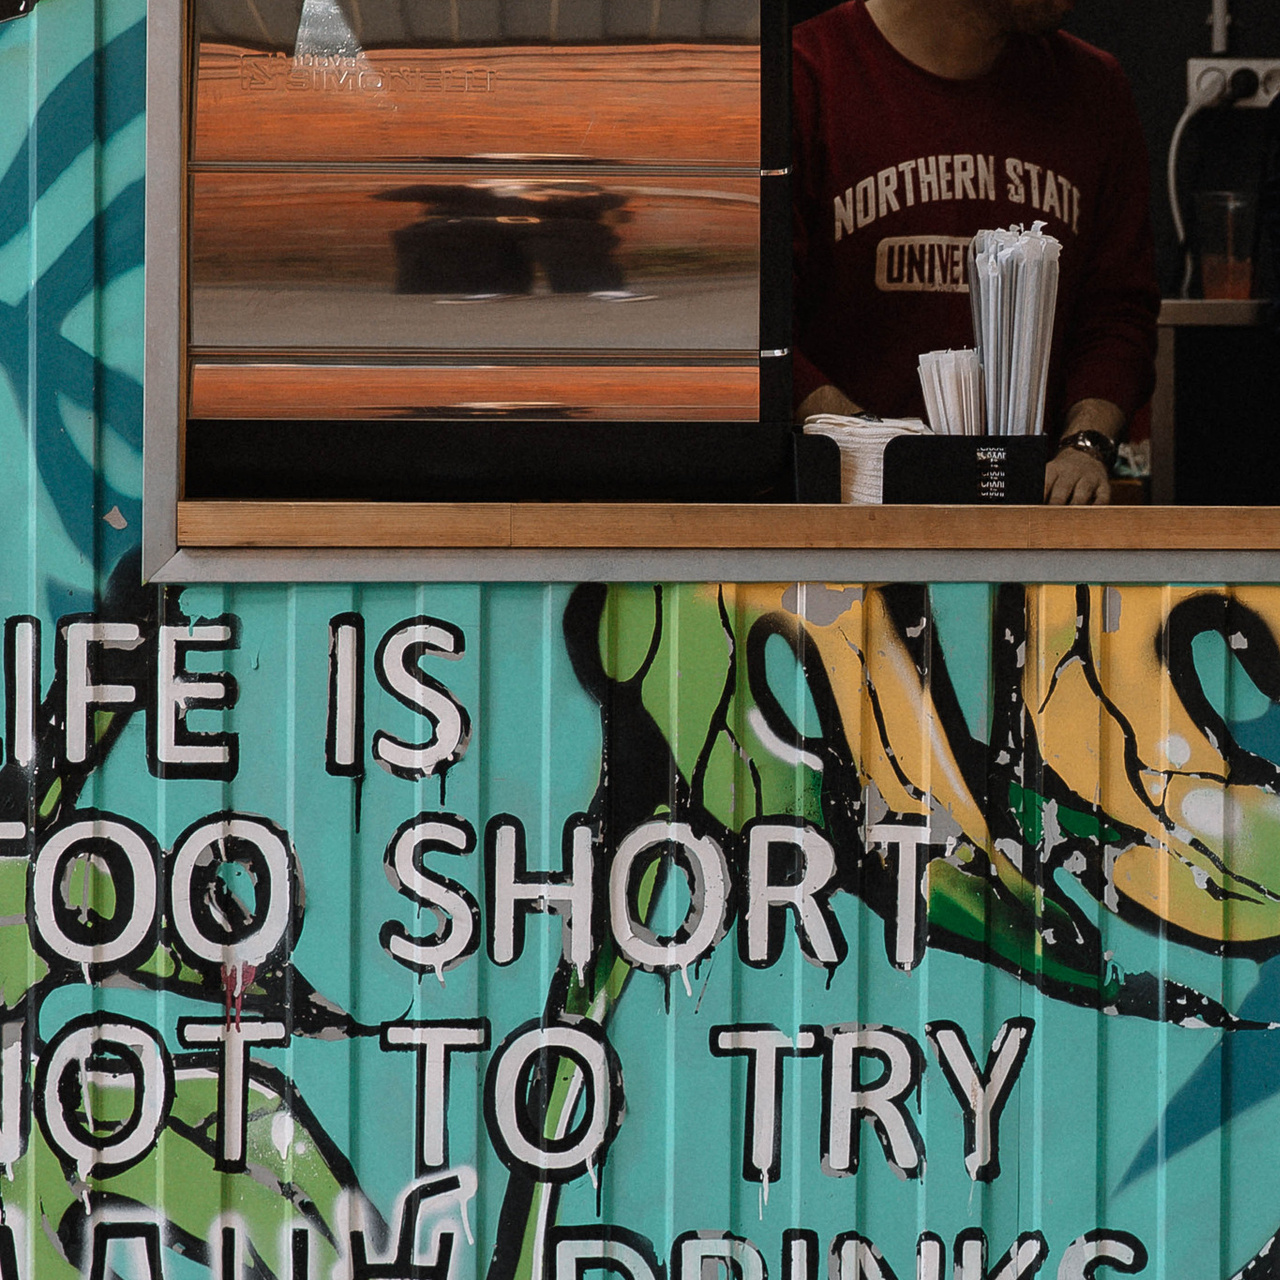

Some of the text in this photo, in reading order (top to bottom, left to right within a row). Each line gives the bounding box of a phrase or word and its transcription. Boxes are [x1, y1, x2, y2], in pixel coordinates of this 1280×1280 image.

[834, 154, 996, 242] NORTHERN
[885, 243, 969, 285] UNIVE
[0, 612, 471, 779] IFE IS
[379, 812, 944, 972] SHORT
[380, 1017, 626, 1182] TO
[710, 1018, 1035, 1182] TRY
